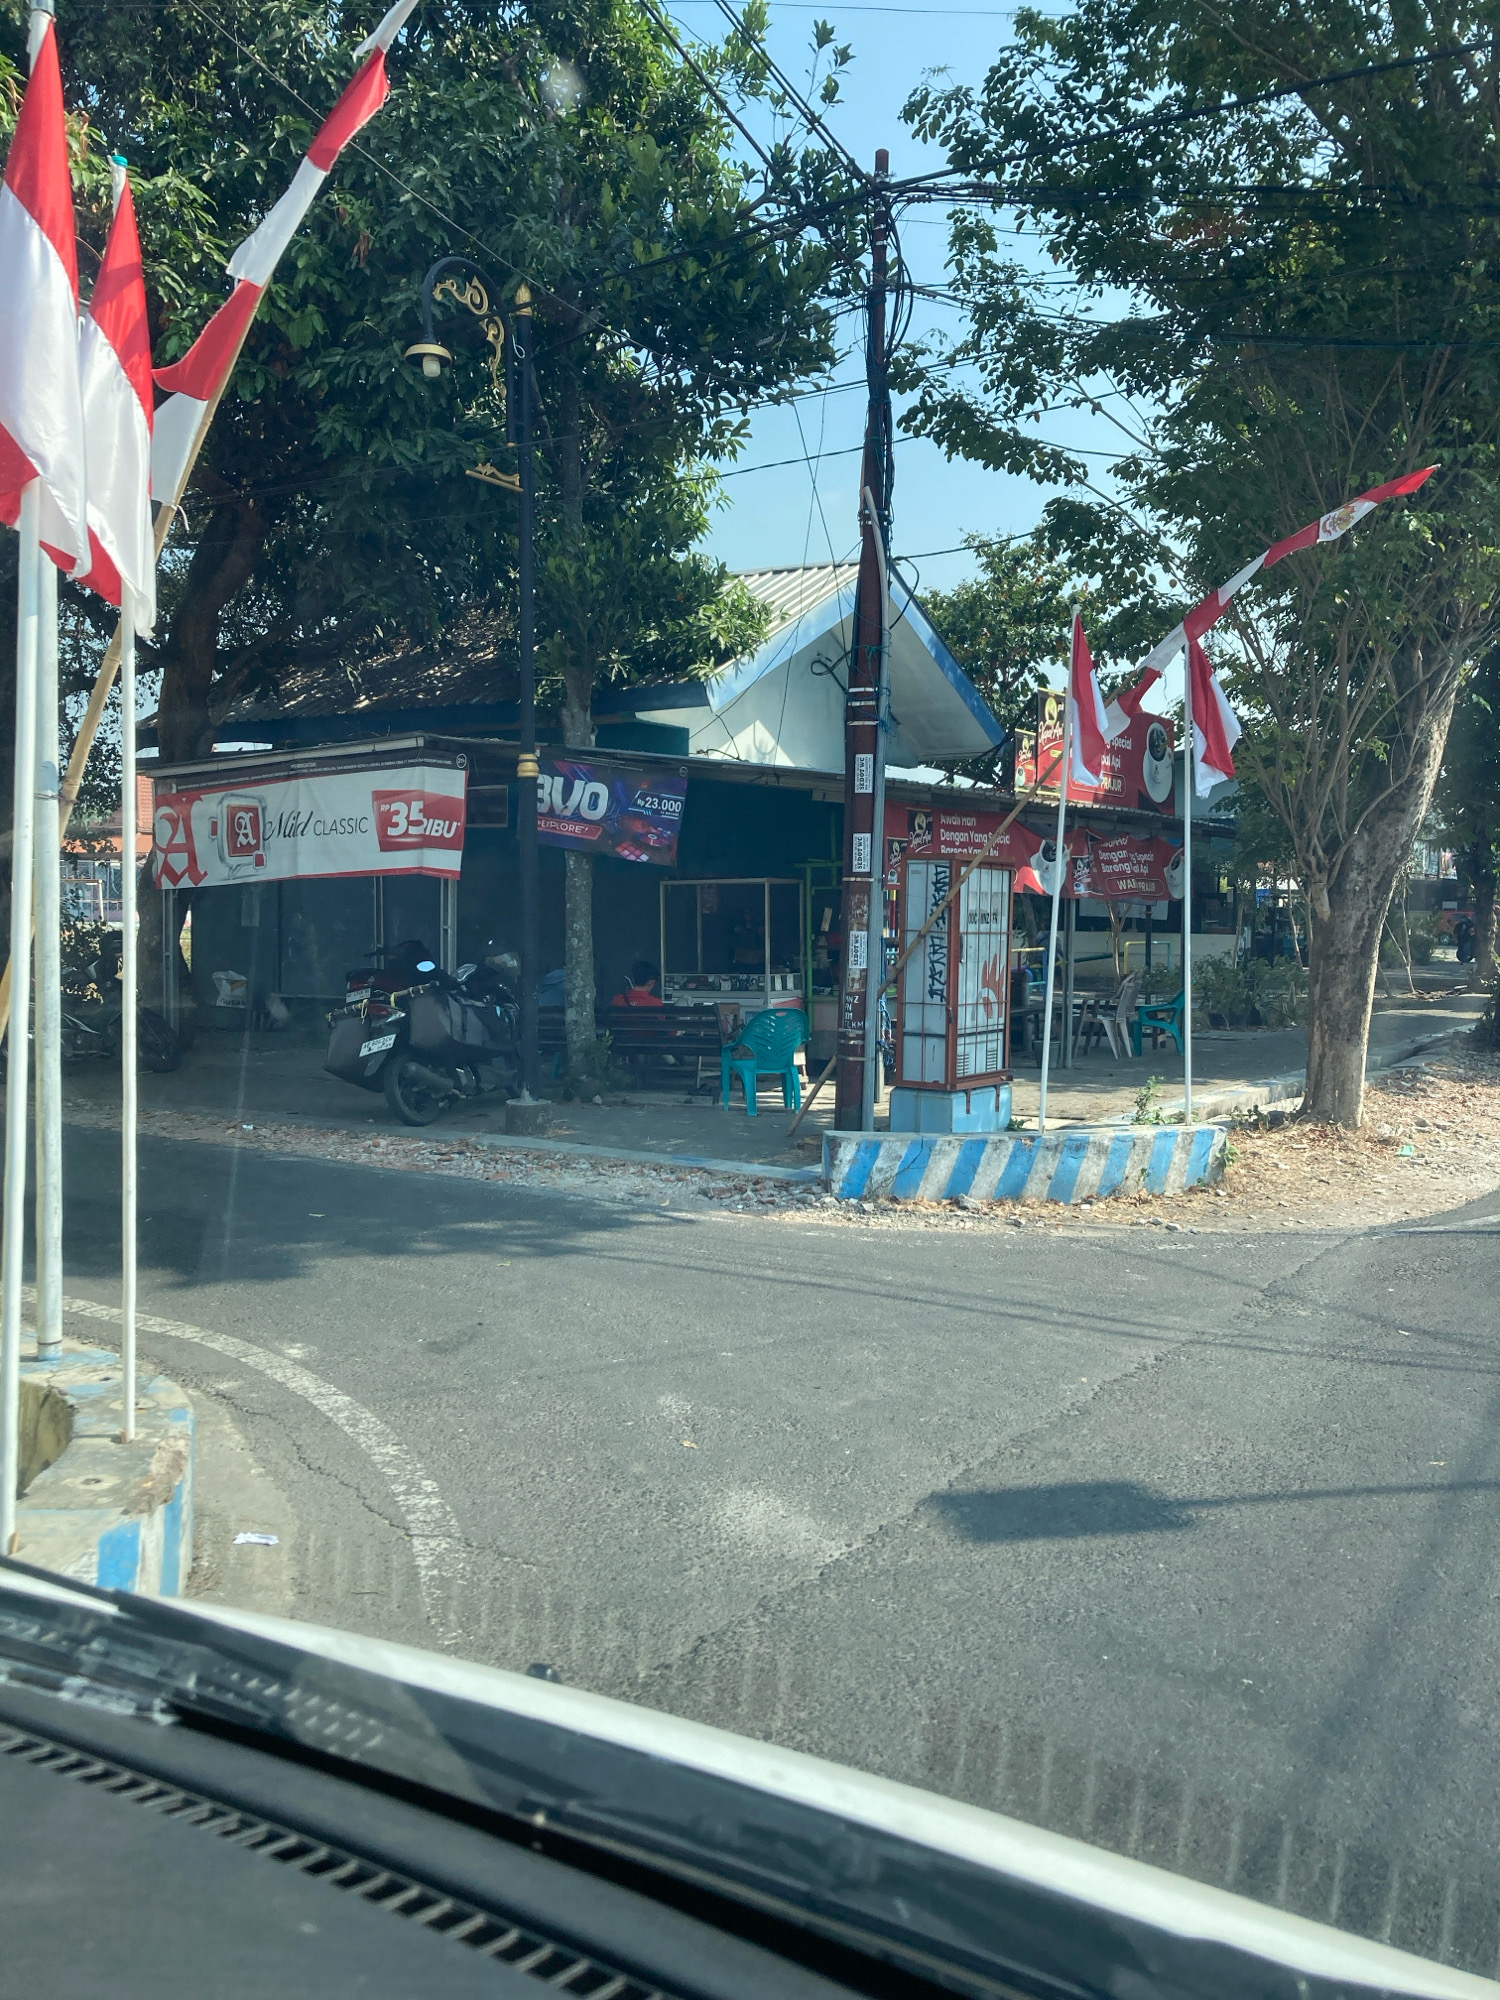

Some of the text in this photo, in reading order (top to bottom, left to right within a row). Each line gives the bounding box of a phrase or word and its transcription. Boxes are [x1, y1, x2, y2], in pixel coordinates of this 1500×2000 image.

[645, 796, 682, 813] 23.000
[262, 809, 314, 842] Mild
[313, 817, 369, 837] CLASSIC
[387, 801, 425, 836] 35
[940, 828, 969, 846] Dengan
[970, 831, 988, 847] Yang
[1098, 850, 1128, 863] Dengan
